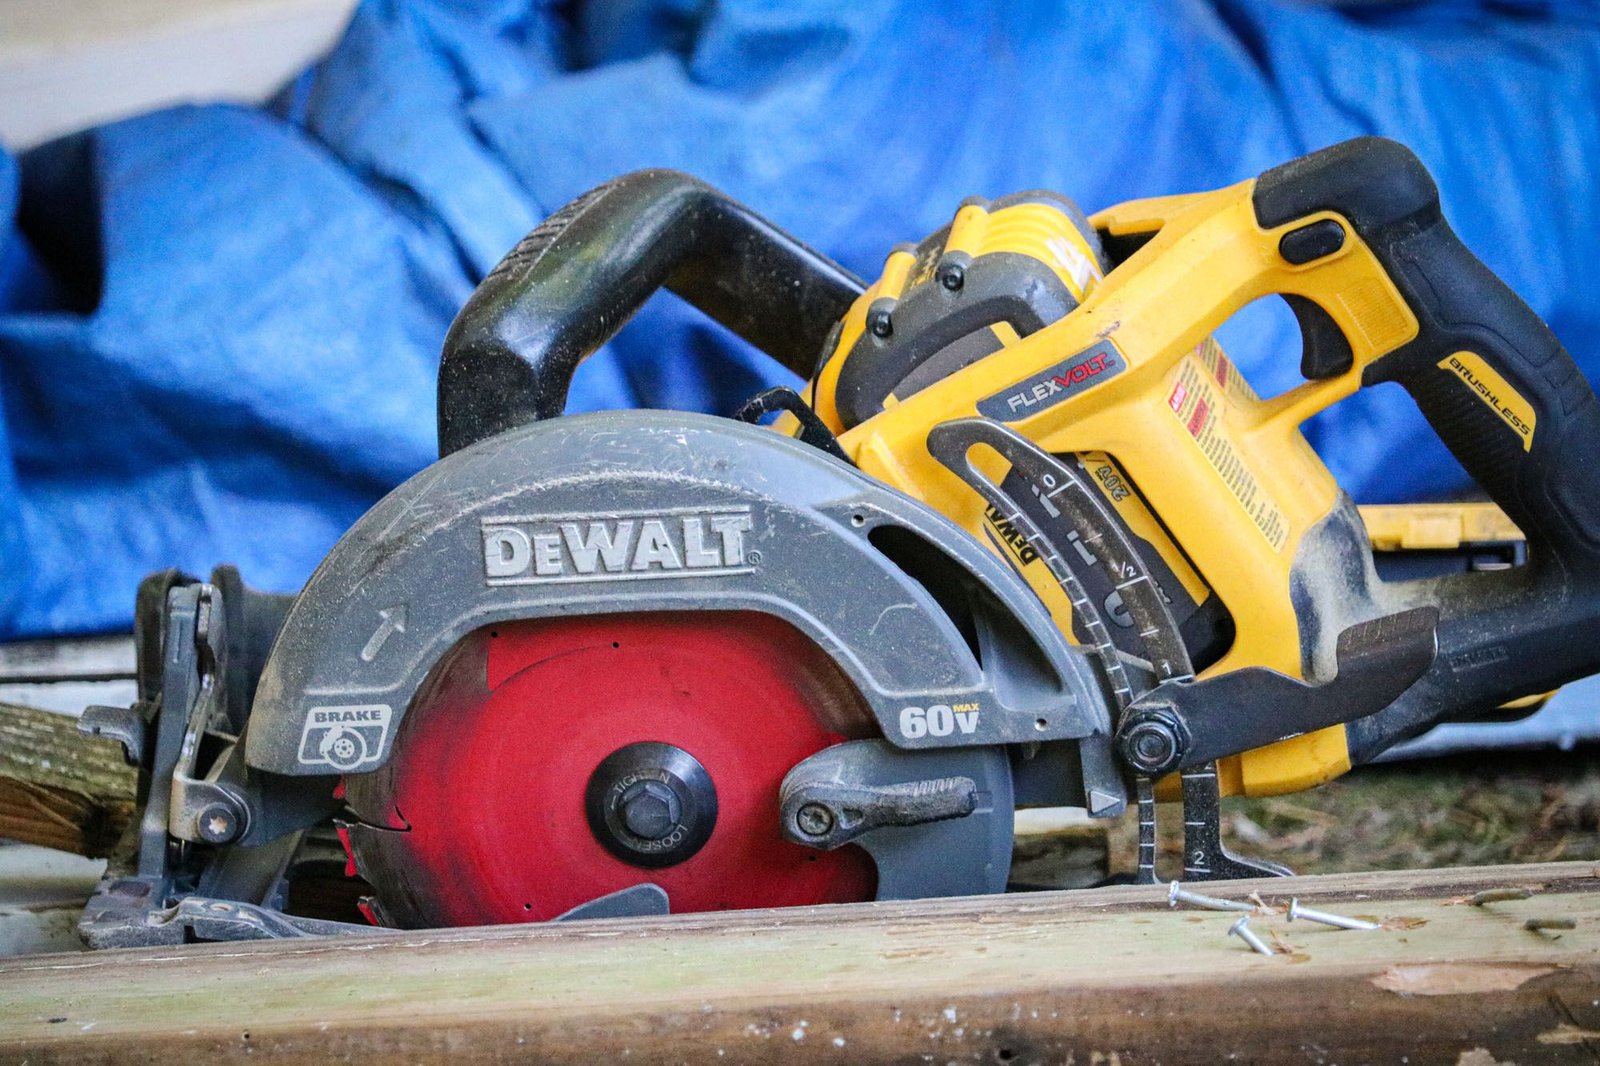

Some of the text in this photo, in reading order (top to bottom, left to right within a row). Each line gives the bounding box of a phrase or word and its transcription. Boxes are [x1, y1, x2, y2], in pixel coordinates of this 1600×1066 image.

[1007, 352, 1107, 413] FLEXVOLT
[1449, 358, 1531, 435] BRUSHLESS
[1043, 474, 1056, 488] 0
[485, 513, 753, 578] DEWALT
[985, 503, 1040, 566] DEWA
[314, 710, 381, 723] BRAKE
[952, 703, 980, 713] MAX
[1193, 850, 1205, 865] 2
